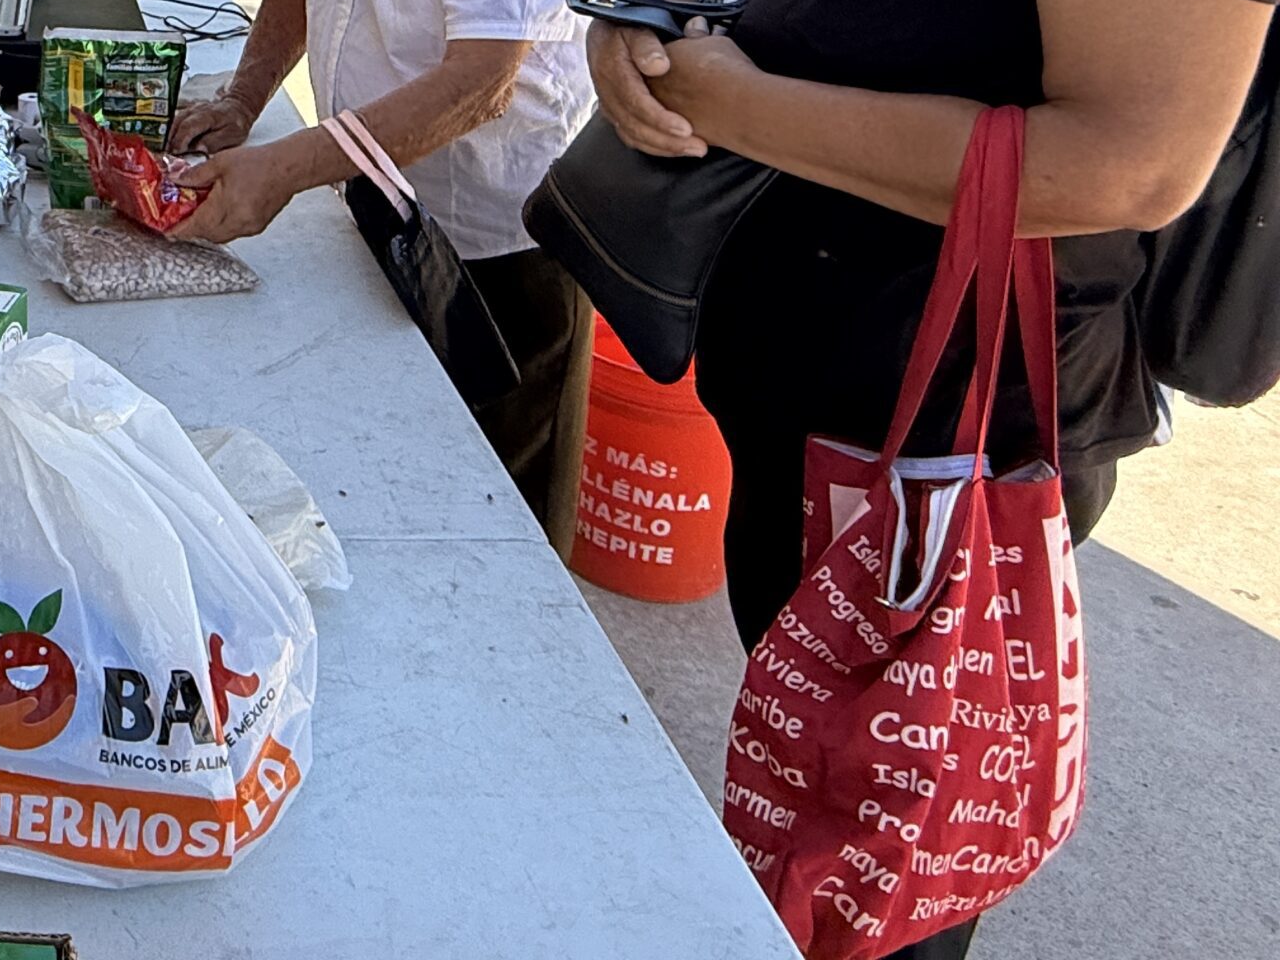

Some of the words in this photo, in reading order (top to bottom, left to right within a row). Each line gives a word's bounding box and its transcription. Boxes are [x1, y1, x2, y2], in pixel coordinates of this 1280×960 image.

[606, 447, 678, 479] MÁS:
[579, 492, 671, 537] HAZLO
[811, 565, 889, 655] Progreso
[1006, 639, 1046, 681] EL
[99, 749, 167, 773] BANCOS
[170, 759, 192, 774] DE
[236, 687, 276, 740] MÉXICO
[739, 687, 804, 739] aribe
[870, 711, 948, 751] Can
[872, 763, 937, 799] Isla
[724, 780, 797, 832] armen
